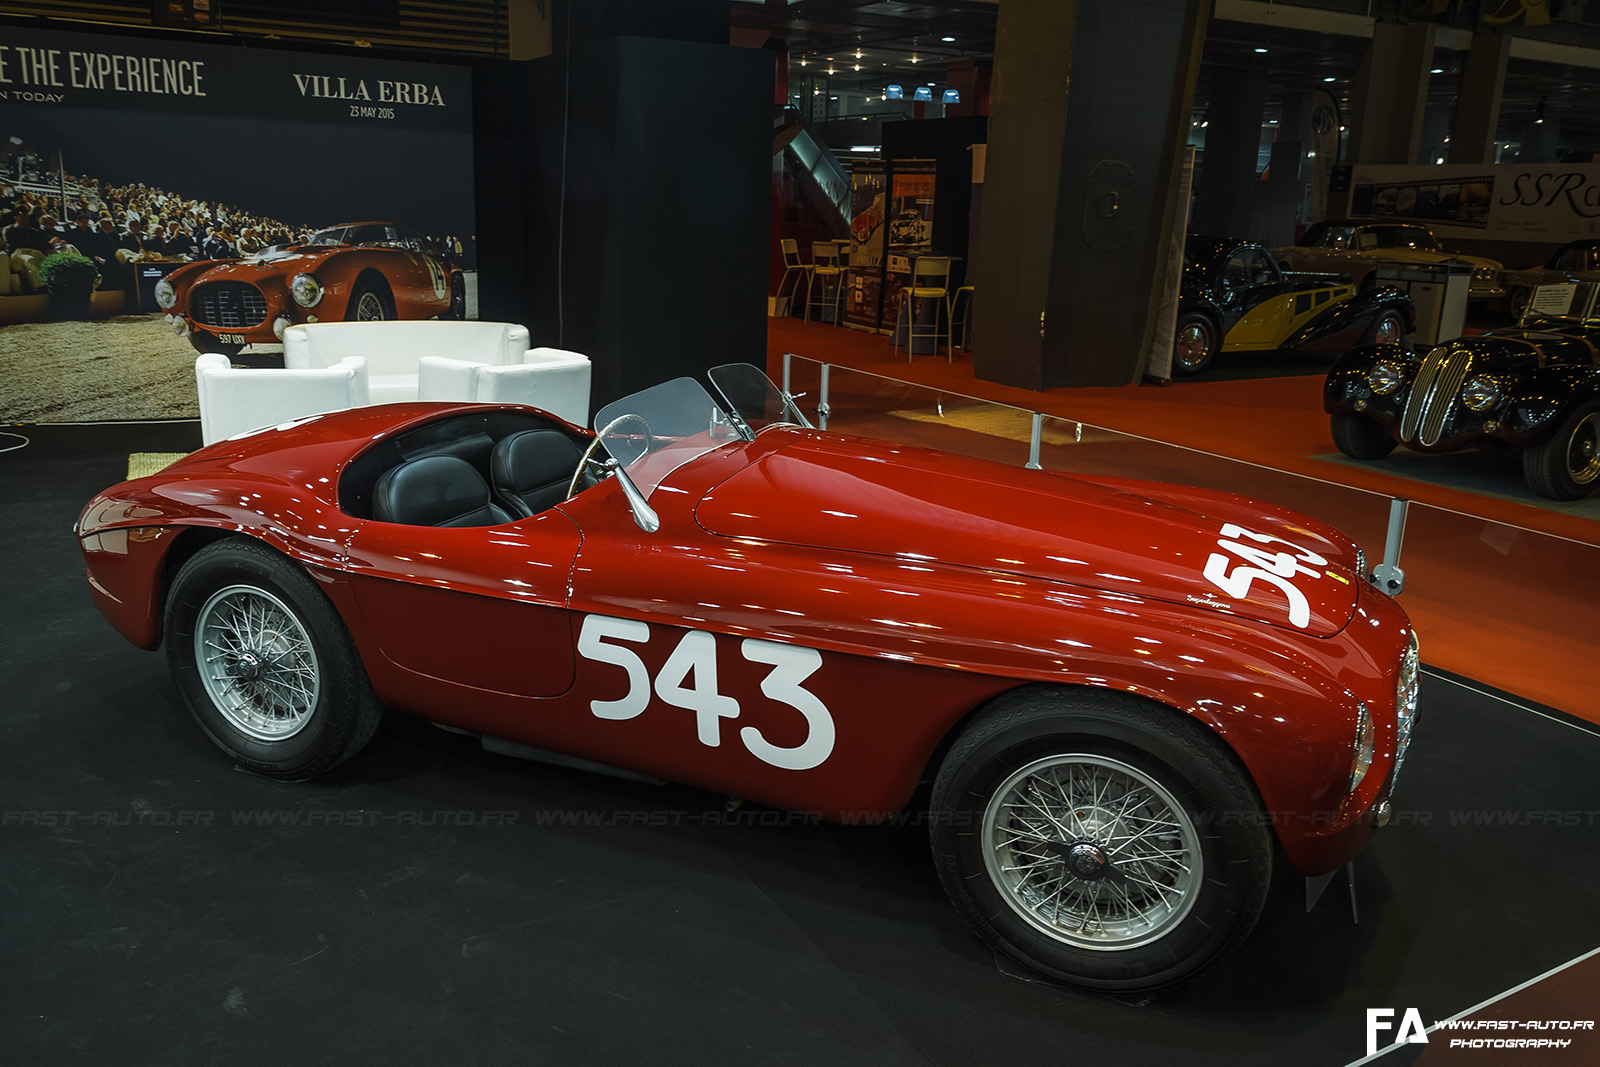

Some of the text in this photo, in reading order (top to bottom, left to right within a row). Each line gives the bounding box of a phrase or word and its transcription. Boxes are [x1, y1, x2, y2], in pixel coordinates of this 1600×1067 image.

[15, 46, 65, 87] THE
[68, 51, 207, 97] EXPERIENCE
[12, 90, 65, 103] TODAY
[292, 73, 446, 107] VILLA ERBA
[349, 105, 395, 119] 23 MAY 2015
[219, 333, 232, 344] 597
[1202, 522, 1329, 629] 543
[577, 613, 836, 771] 543
